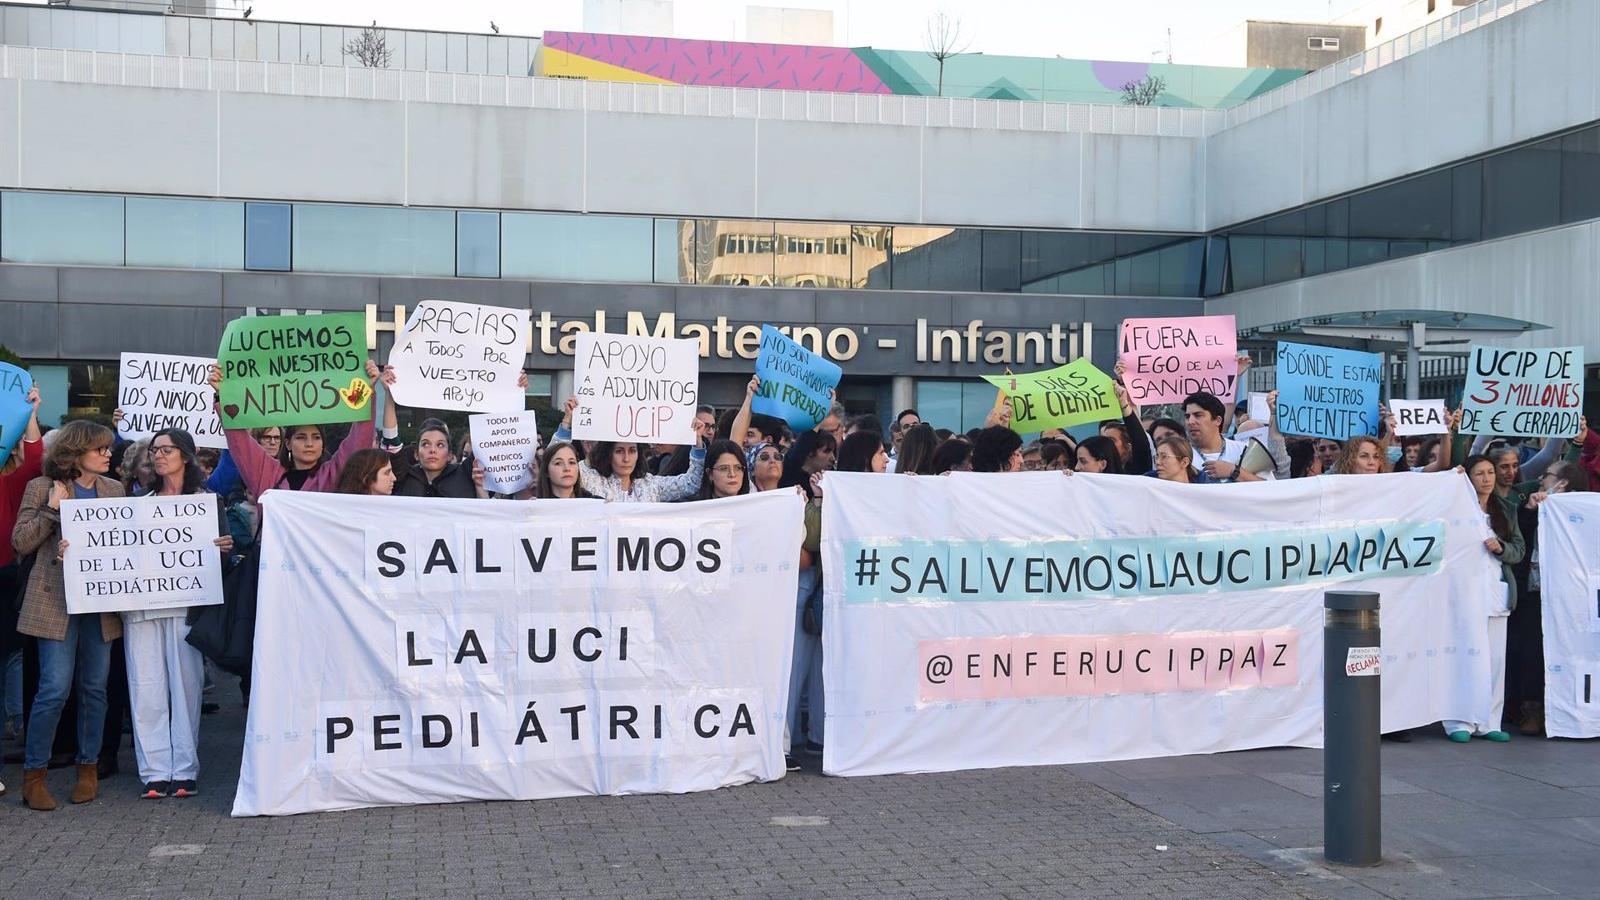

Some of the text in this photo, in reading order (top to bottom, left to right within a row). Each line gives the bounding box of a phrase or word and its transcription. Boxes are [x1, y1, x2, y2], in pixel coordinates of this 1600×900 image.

[229, 326, 352, 352] LUCHEMOS
[763, 335, 809, 365] NO SON
[916, 318, 1092, 364] Infantil
[1123, 323, 1224, 354] ¡FUERA EL
[226, 350, 360, 379] POR NUESTROS
[403, 341, 414, 353] A
[483, 346, 510, 365] POR
[588, 340, 667, 374] APOYO
[1137, 355, 1223, 374] EGO DE LA
[1476, 348, 1573, 379] UCIP DE
[125, 359, 214, 386] SALVEMOS
[419, 365, 497, 383] VUESTRO
[584, 375, 592, 384] A
[765, 355, 833, 400] PROGRAMADOS
[1343, 364, 1380, 385] ESTÁN
[121, 386, 148, 407] LOS
[243, 378, 341, 416] NIÑOS
[442, 385, 484, 408] APOYO
[577, 376, 697, 406] LOS ADJUNTOS
[756, 379, 827, 424] SON FORZADOS
[1012, 385, 1110, 422] DE CIERRE
[1304, 384, 1364, 405] NUESTROS
[1470, 380, 1581, 408] 3 MILLONES
[120, 413, 189, 434] SALVEMOS
[486, 416, 519, 426] TODO MI
[579, 418, 592, 426] LA
[580, 406, 593, 415] DE
[1400, 408, 1440, 425] REA
[1460, 408, 1579, 435] DE € CERRADA
[491, 427, 517, 436] APOYO
[504, 475, 522, 484] UCIP
[73, 502, 207, 522] APOYO A LOS
[87, 526, 193, 548] MÉDICOS
[79, 549, 204, 572] DE LA UCI
[376, 536, 722, 578] SALVEMOS
[855, 535, 1437, 596] #SALVEMOSLAUCIPLAPAZ
[86, 576, 203, 596] PEDIÁTRICA
[406, 626, 628, 667] LA UCI
[926, 643, 1288, 684] @ENFERUCIPPAZ
[326, 701, 757, 754] PEDIÁTRICA
